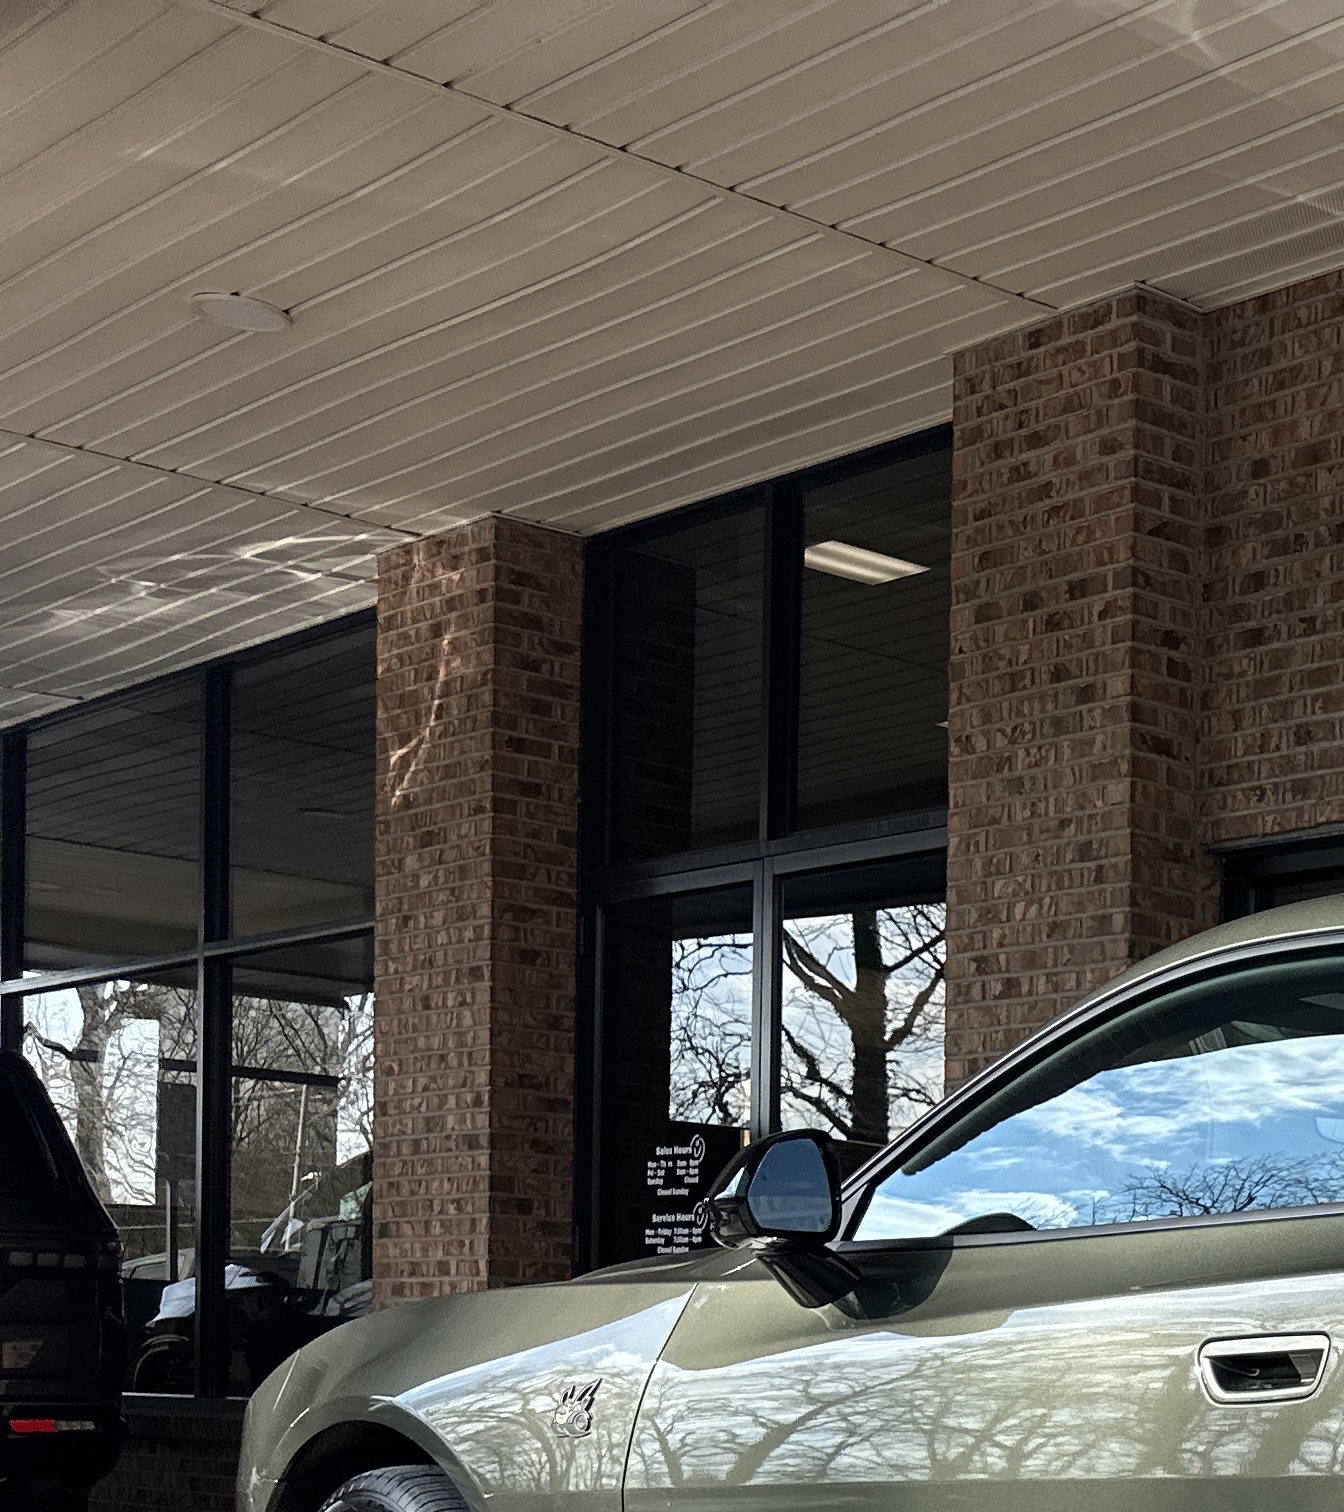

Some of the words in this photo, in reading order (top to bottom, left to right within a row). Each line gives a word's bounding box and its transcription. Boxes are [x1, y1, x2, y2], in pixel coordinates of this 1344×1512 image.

[656, 1146, 672, 1155] Sales
[674, 1145, 692, 1154] Hours
[652, 1213, 675, 1223] Service
[676, 1213, 695, 1222] Hours
